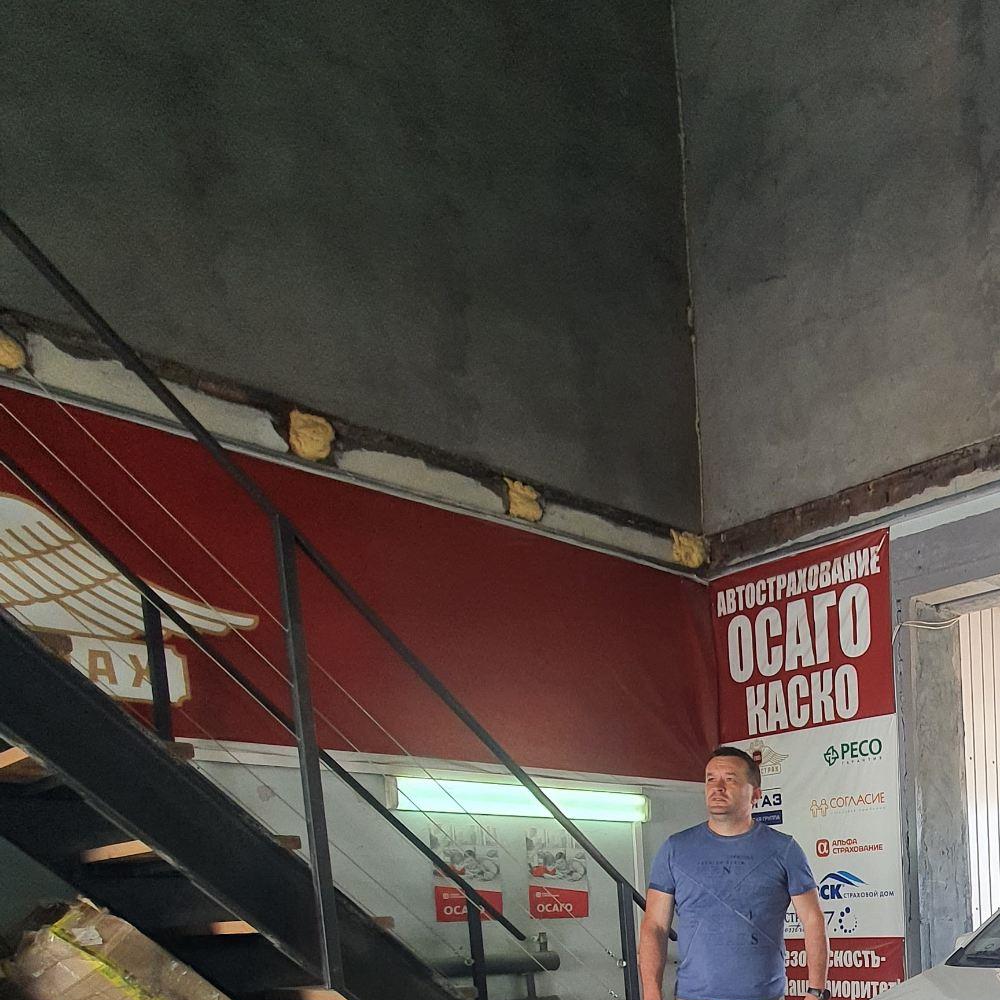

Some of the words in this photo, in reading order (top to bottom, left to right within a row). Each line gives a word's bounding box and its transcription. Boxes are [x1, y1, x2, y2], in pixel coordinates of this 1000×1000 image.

[717, 545, 881, 618] АВТОСТРАХОВАНИЕ
[727, 582, 872, 683] ОСАГО
[745, 663, 859, 736] КАСКО
[841, 738, 882, 760] РЕСО
[830, 792, 885, 808] СОГЛАСИЕ
[832, 838, 858, 846] АЛЬФА
[832, 844, 883, 854] СТРАХОВАНИЕ
[844, 890, 879, 899] СТРАХОВОЙ
[536, 903, 573, 913] ОСАГО
